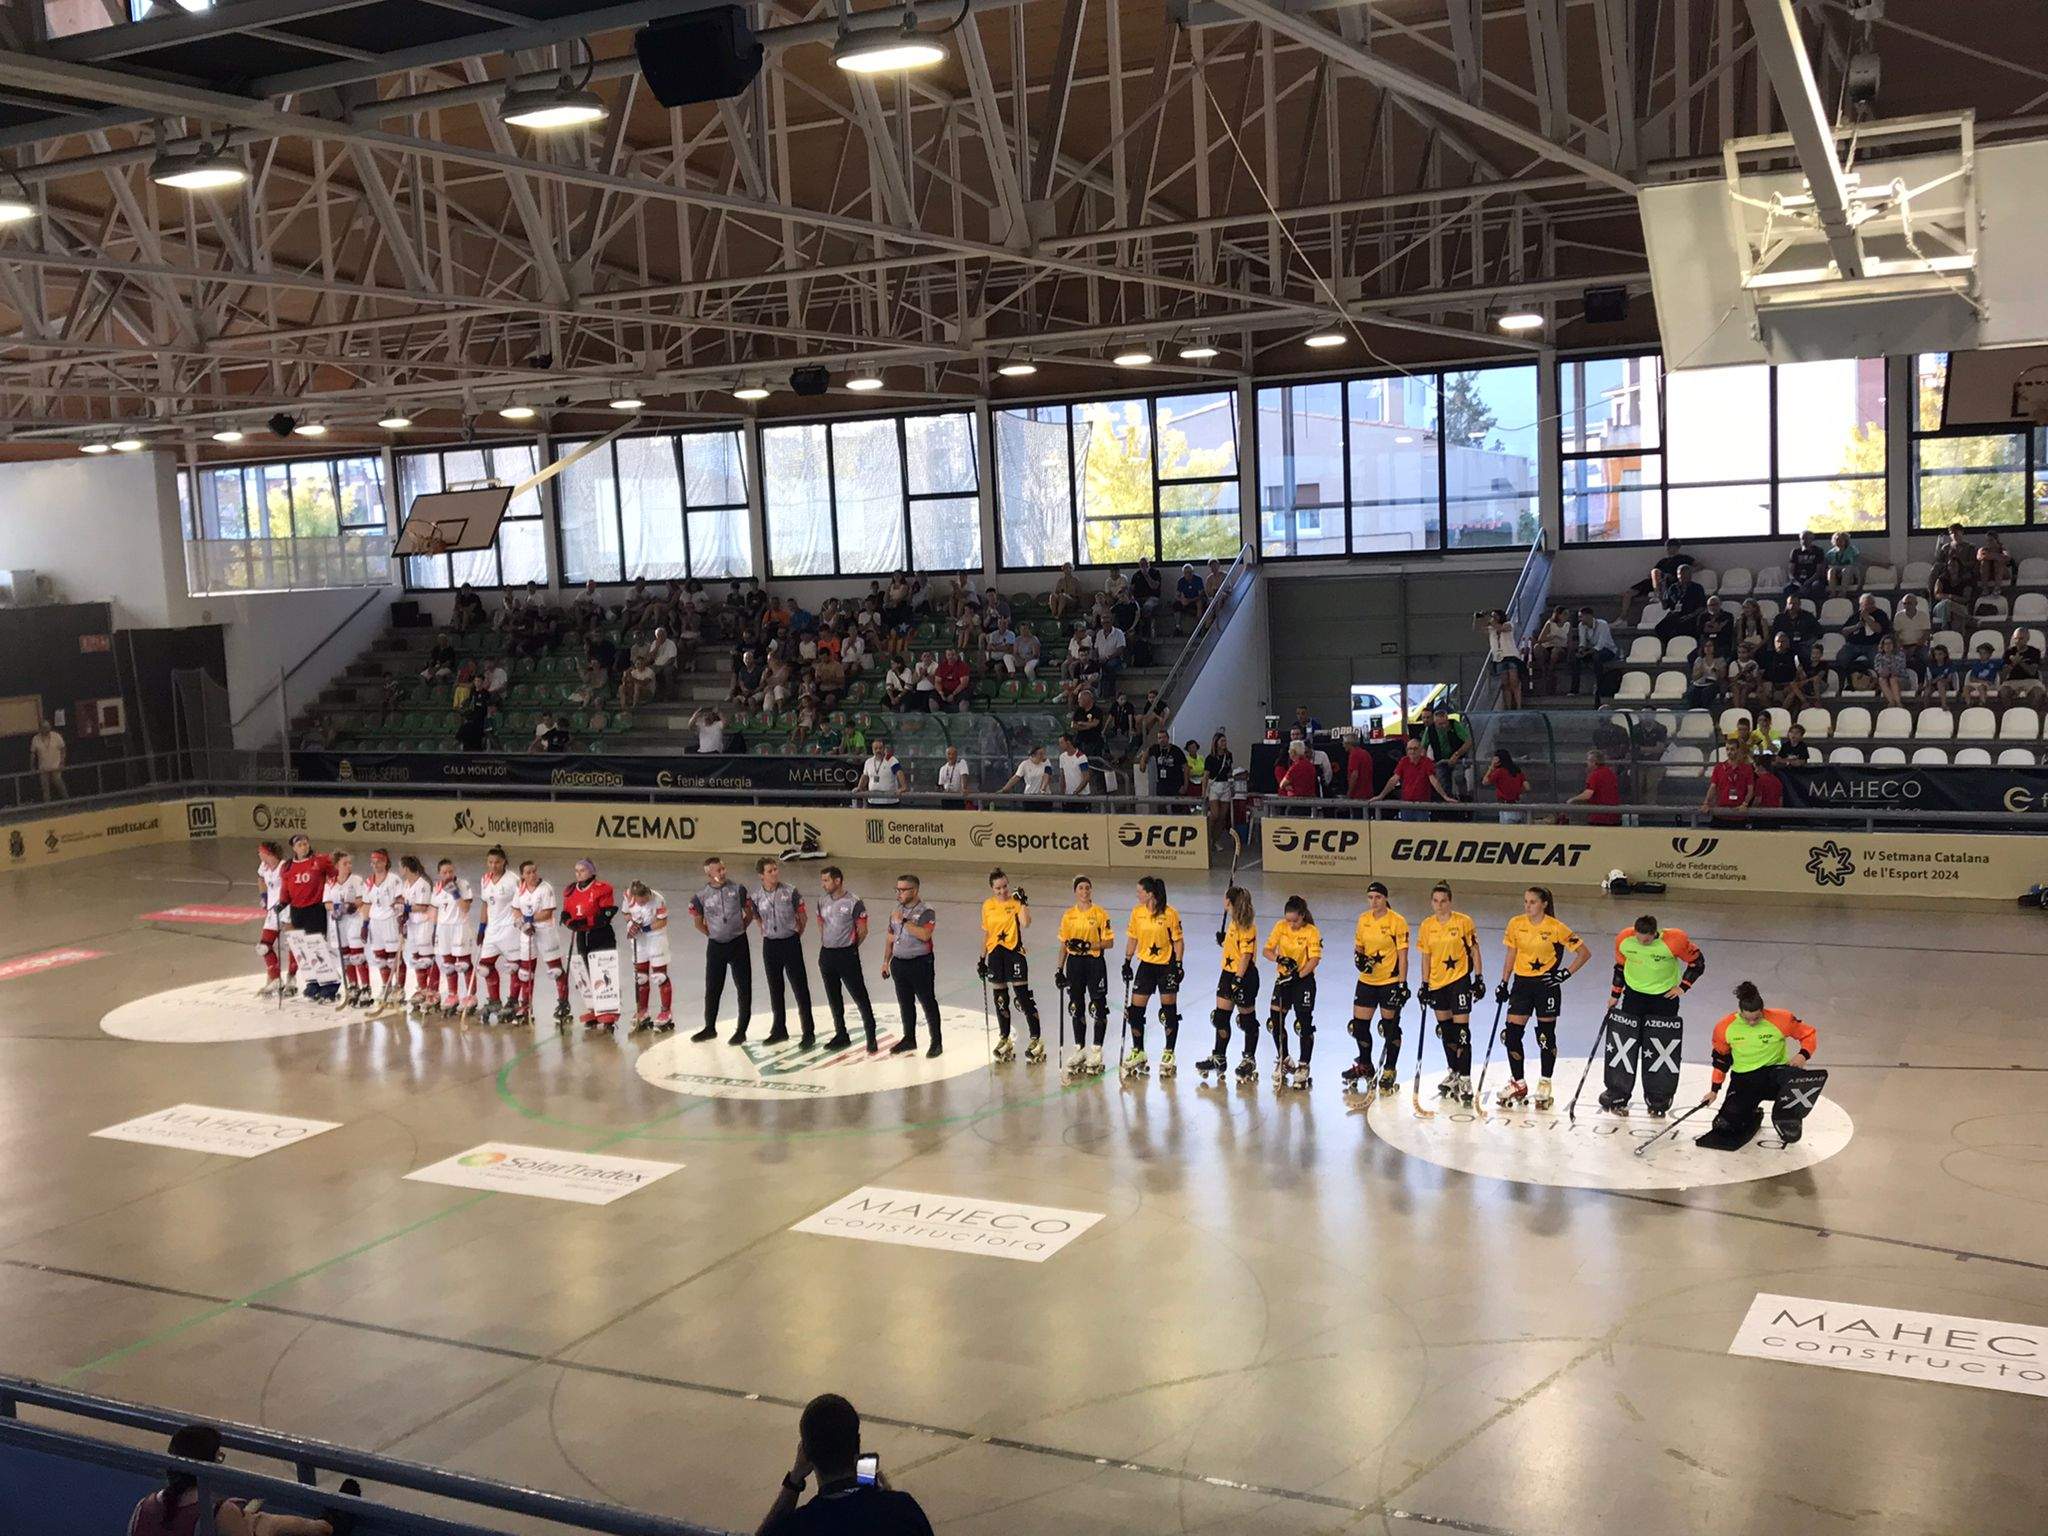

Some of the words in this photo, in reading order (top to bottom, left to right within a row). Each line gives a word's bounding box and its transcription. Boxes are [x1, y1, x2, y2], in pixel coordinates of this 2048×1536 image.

[788, 768, 858, 783] MAHECO
[1808, 780, 1922, 798] MAHECO
[273, 807, 306, 818] WORLD
[361, 808, 403, 820] Loteries
[273, 818, 307, 830] SKATE
[362, 820, 415, 835] Catalunya
[488, 816, 554, 836] hockeymania
[595, 815, 696, 840] AZEMAD
[741, 817, 802, 845] 3cat
[888, 821, 944, 833] Generalitat
[888, 834, 901, 845] de
[904, 834, 956, 849] Catalunya
[995, 832, 1090, 853] esportcat
[1146, 825, 1198, 847] FCP
[1303, 830, 1359, 852] FCP
[1391, 839, 1591, 867] GOLDENCAT
[1863, 851, 1876, 861] IV
[1879, 851, 1931, 862] Setmana
[1935, 852, 1990, 864] Catalana
[1655, 861, 1674, 869] Unió
[1676, 862, 1686, 870] de
[1688, 862, 1738, 871] Federacions
[294, 873, 311, 884] 10
[1648, 870, 1691, 880] Esportives
[1692, 871, 1703, 879] de
[1705, 872, 1746, 881] Catalunya
[1863, 867, 1878, 878] de
[1881, 868, 1928, 880] l'Esport
[1931, 870, 1959, 880] 2024
[1013, 964, 1021, 975] 5
[1304, 991, 1311, 1002] 2
[1458, 993, 1467, 1006] 8
[1547, 997, 1555, 1010] 9
[1609, 1013, 1638, 1028] AZEMAD
[1644, 1020, 1681, 1029] AZEMAD
[847, 1197, 1071, 1234] MAHECO
[823, 1215, 1046, 1251] constructora
